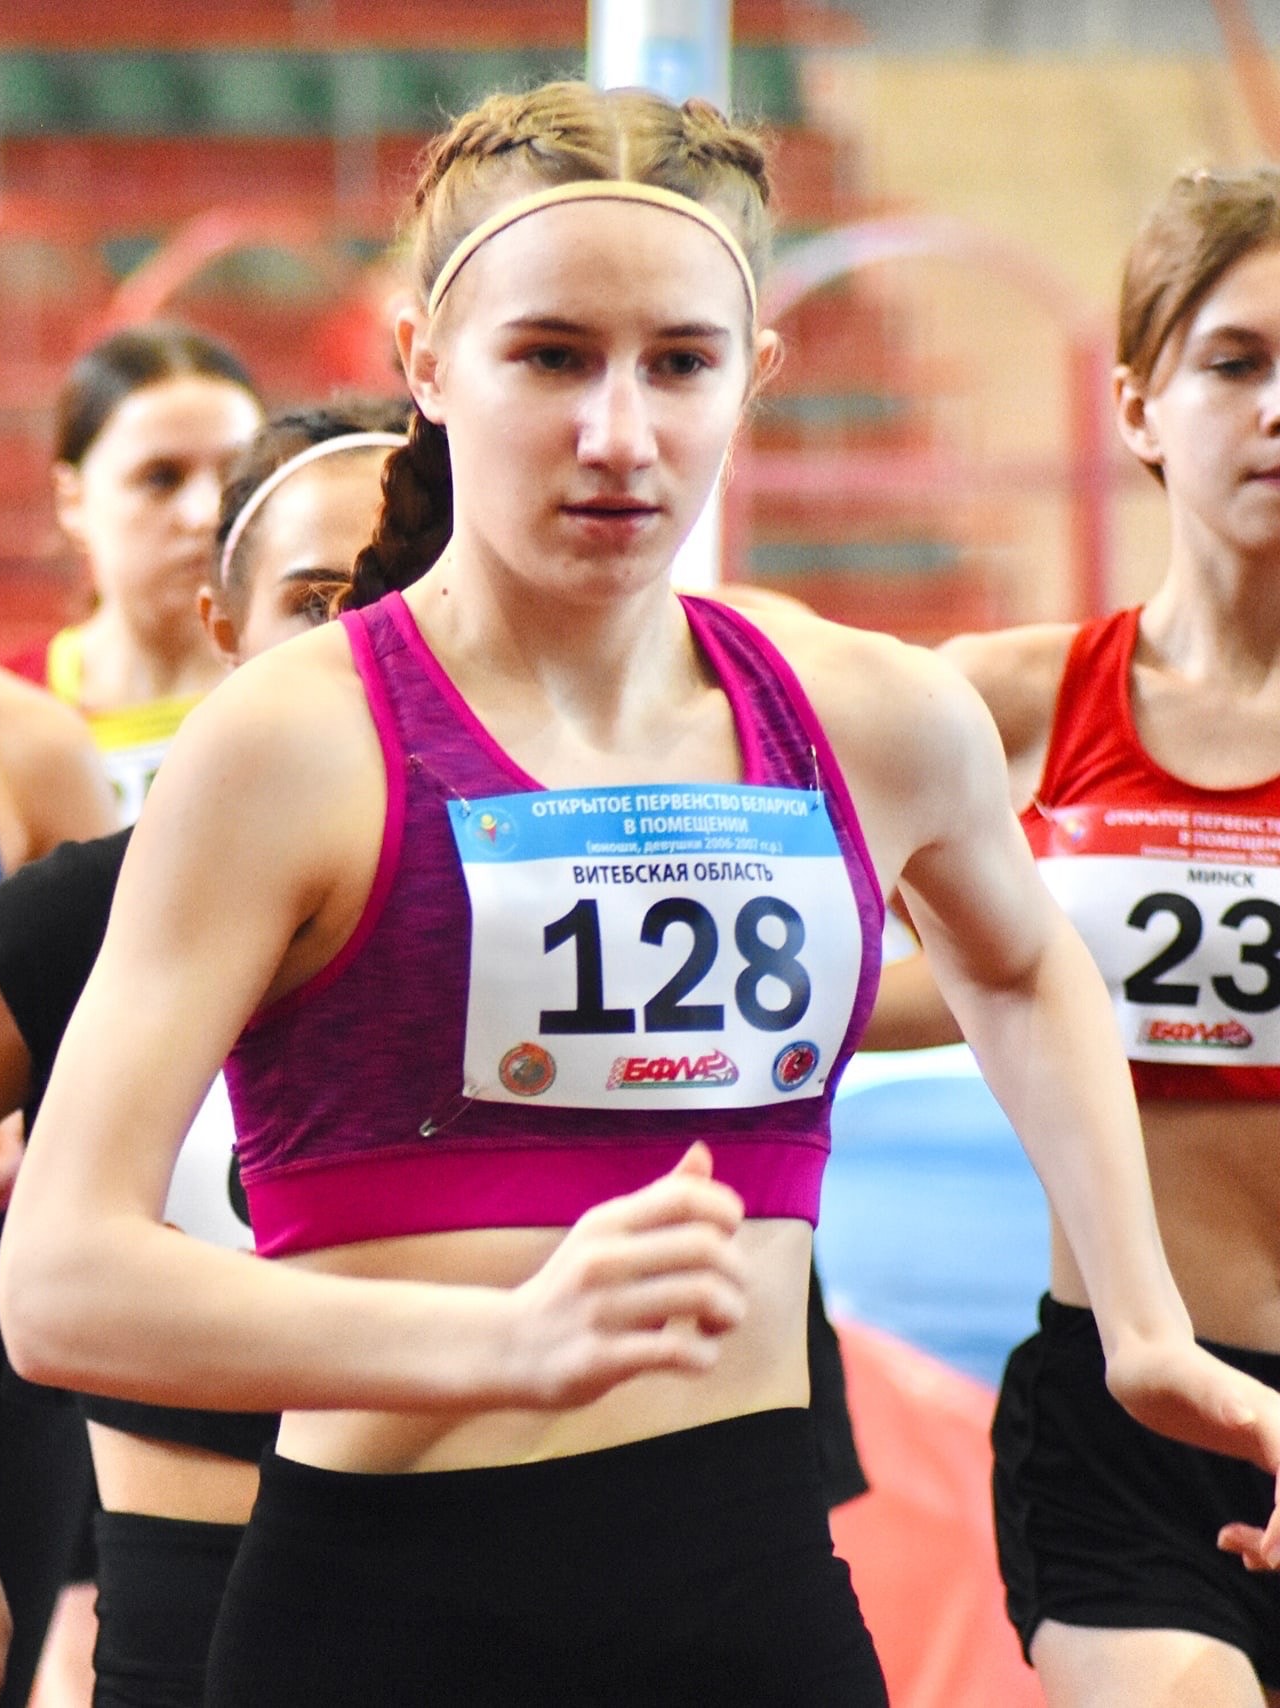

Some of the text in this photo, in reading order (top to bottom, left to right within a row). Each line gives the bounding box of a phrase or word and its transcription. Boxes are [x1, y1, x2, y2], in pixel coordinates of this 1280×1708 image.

[532, 793, 809, 817] ОТКРЫТОЕ ПЕРВЕНСТВО БЕЛАРУСИ
[623, 816, 749, 835] В ПОМЕЩЕНИИ
[573, 862, 774, 884] ВИТЕБСКАЯ ОБЛАСТЬ
[1187, 868, 1255, 888] МИНСК
[1123, 891, 1280, 1014] 23
[539, 896, 811, 1035] 128
[623, 1054, 726, 1083] БФЛА
